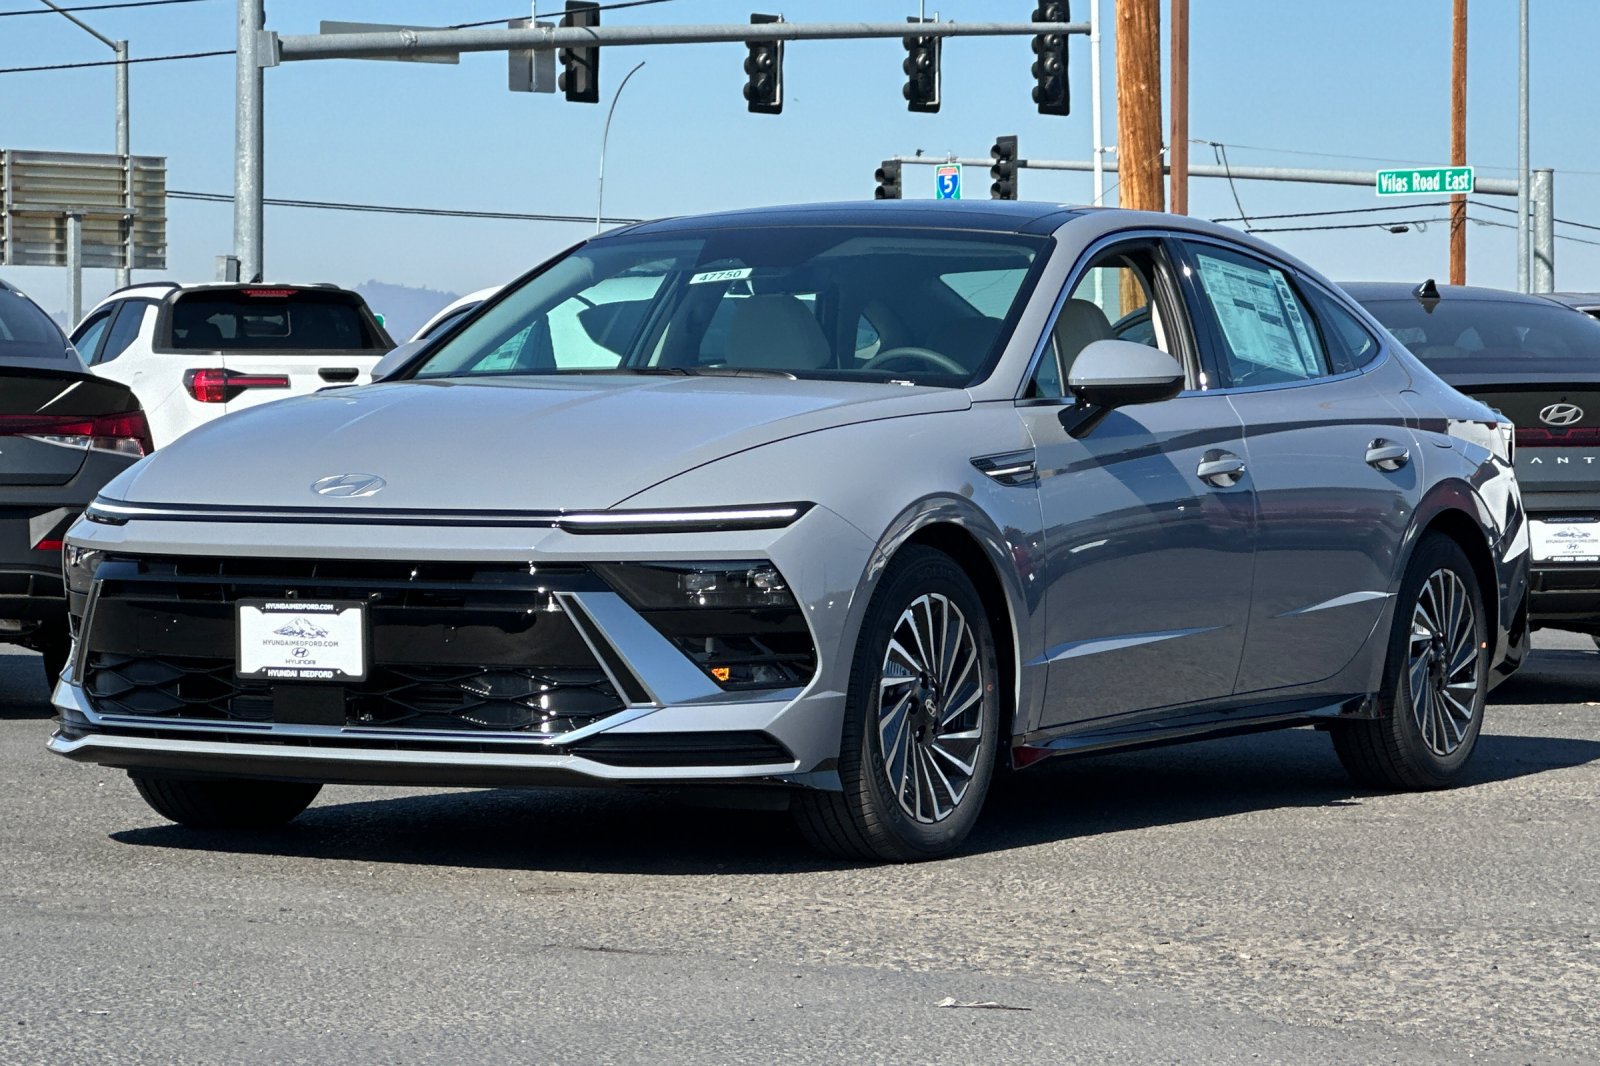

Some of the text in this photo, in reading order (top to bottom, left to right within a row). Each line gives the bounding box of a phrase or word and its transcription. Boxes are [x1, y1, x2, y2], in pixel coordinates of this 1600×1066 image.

[943, 175, 953, 194] 5
[1380, 170, 1470, 193] Vilas Road East
[698, 270, 743, 281] 47750
[265, 602, 334, 611] HYUNDAIMEDFORD.COM
[262, 639, 339, 648] HYUNDAIMEDFORD.COM
[267, 669, 334, 679] HYUNDAI MEDFORD
